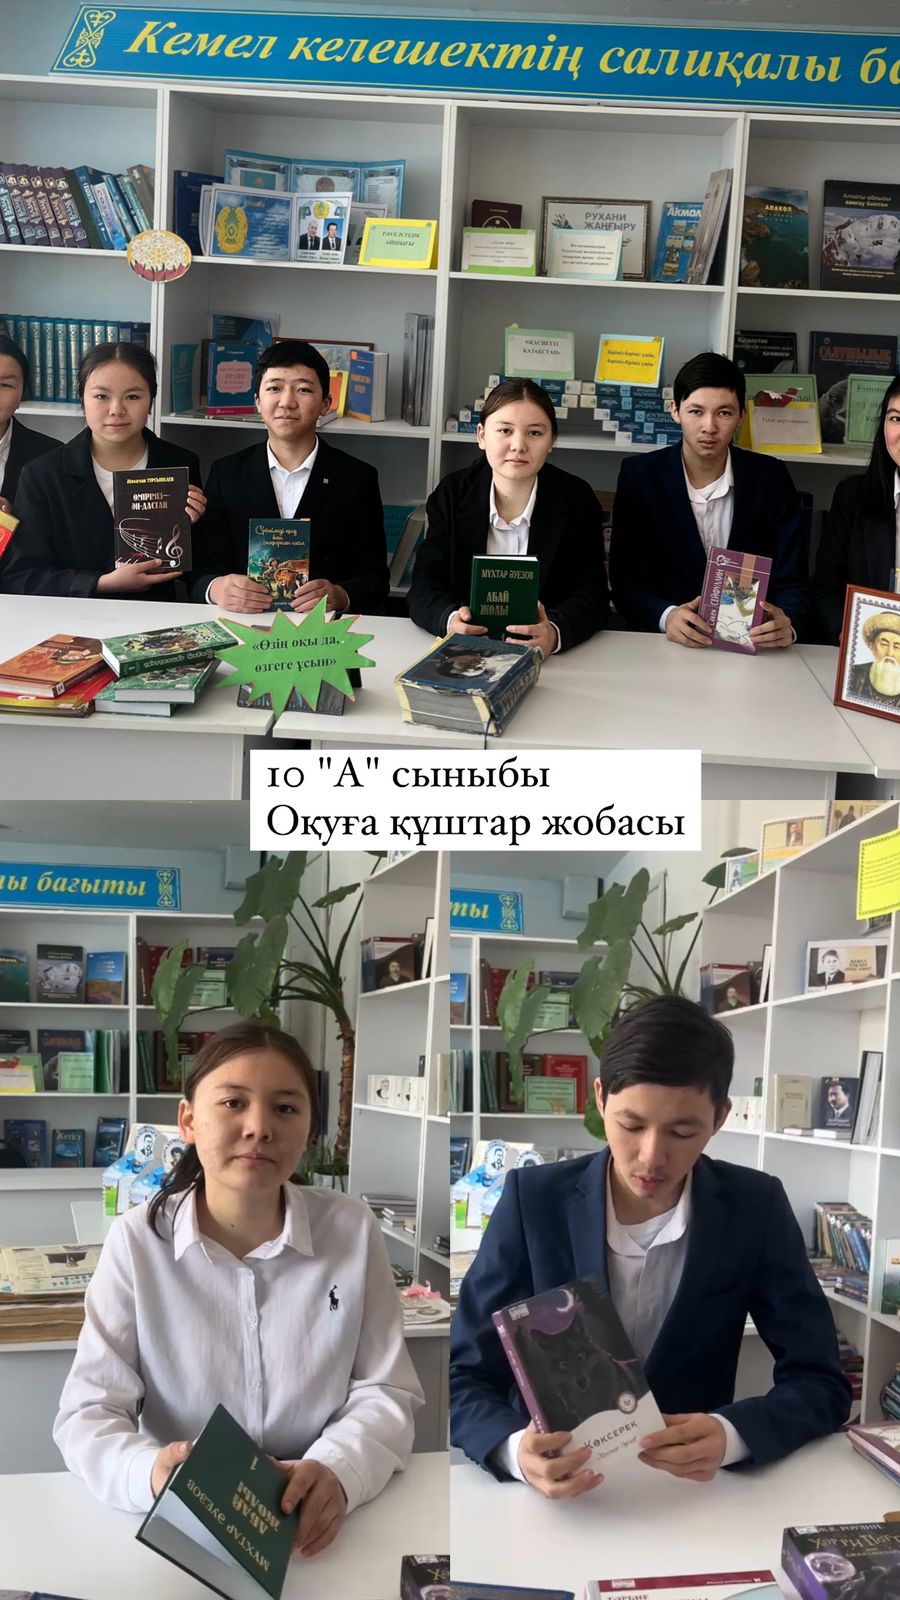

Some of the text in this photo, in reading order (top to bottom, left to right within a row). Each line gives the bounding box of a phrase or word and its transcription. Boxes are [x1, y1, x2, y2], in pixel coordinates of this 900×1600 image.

[124, 20, 274, 60] Кемел
[288, 33, 584, 80] келешектің
[599, 46, 842, 88] салиқалы
[584, 212, 627, 221] РУХАНИ
[481, 569, 508, 579] МҰХТАР
[486, 590, 510, 603] АБАЙ
[480, 604, 509, 616] ЖОЛЫ
[252, 637, 288, 652] «Өзің
[292, 636, 318, 649] оқы
[255, 658, 337, 673] өзгеге ұсын»
[584, 1420, 638, 1449] КӨКСЕРЕК
[187, 1479, 226, 1525] ӘУЕЗОВ
[237, 1481, 280, 1532] ЖОЛЫ
[232, 1492, 268, 1535] АБАЙ
